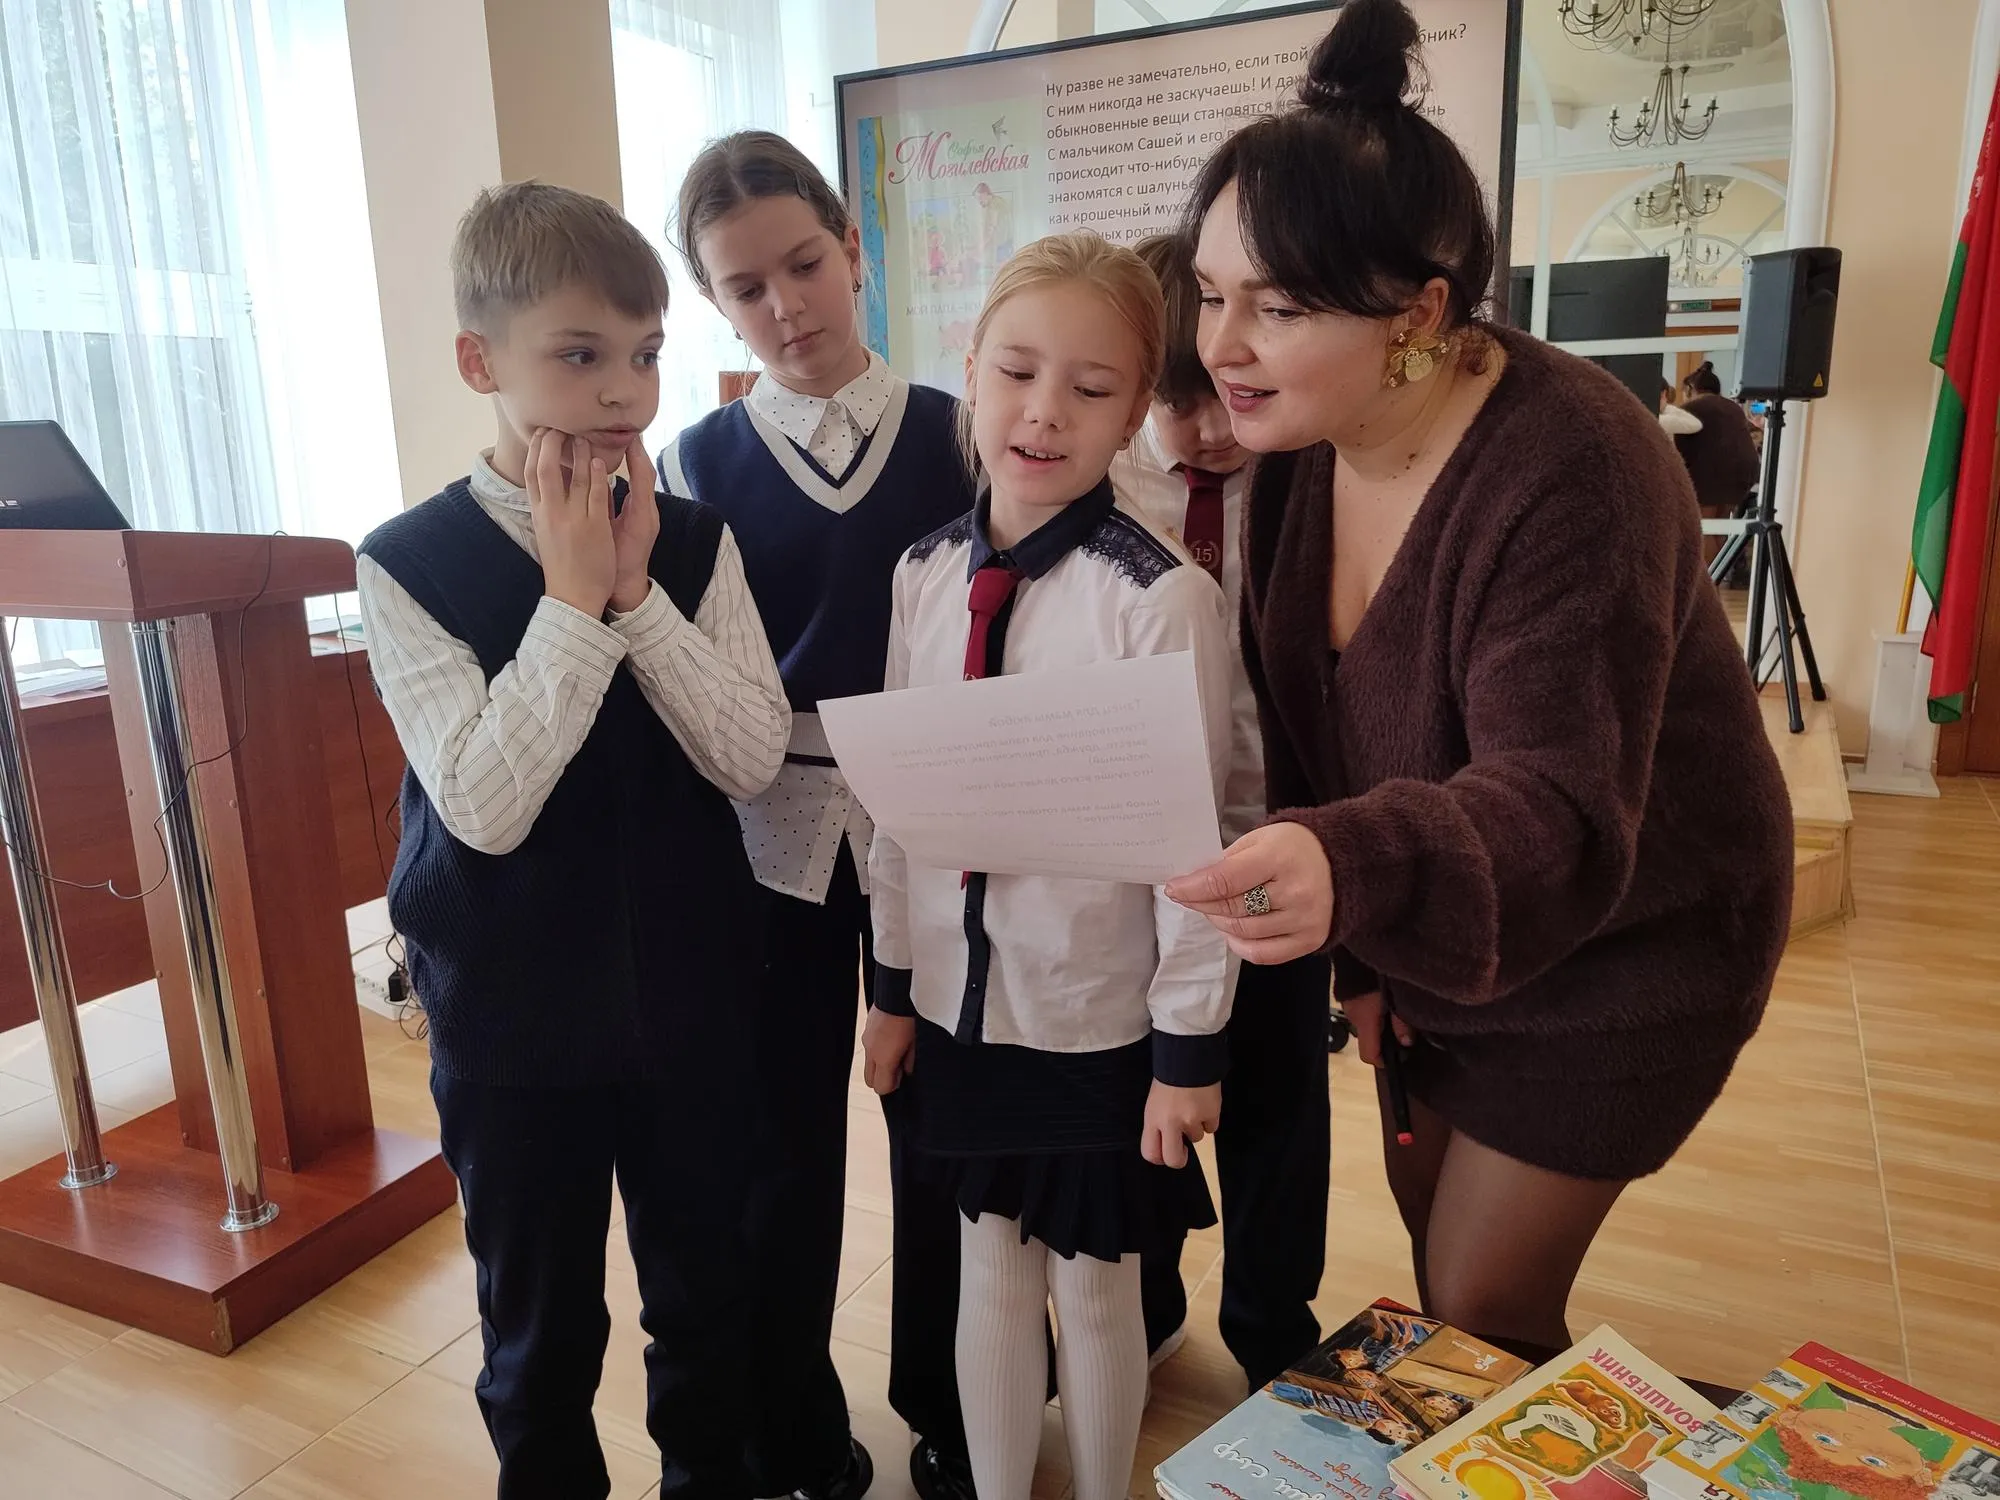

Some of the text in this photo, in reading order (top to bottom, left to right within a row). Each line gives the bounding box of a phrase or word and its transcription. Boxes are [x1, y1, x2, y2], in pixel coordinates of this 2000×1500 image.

[1046, 23, 1467, 98] Ну разве не замечательно, если твой бник?
[1046, 105, 1055, 118] С
[1058, 103, 1085, 117] ним
[1089, 95, 1142, 113] никогда
[1147, 93, 1164, 105] не
[1167, 77, 1256, 101] заскучаешь!
[1261, 76, 1271, 89] И
[1047, 117, 1149, 139] обыкновенные
[1153, 112, 1190, 126] вещи
[1194, 101, 1272, 120] становятся
[888, 131, 1030, 184] Могилевская
[1048, 148, 1056, 160] С
[1059, 142, 1134, 160] мальчиком
[1138, 132, 1183, 150] Сашей
[1187, 135, 1195, 144] и
[1200, 131, 1222, 142] его
[1048, 155, 1205, 184] происходит что-нибудь
[1048, 180, 1196, 203] знакомятся с шалунье
[1049, 202, 1188, 224] как крошечный мухо
[1126, 225, 1171, 241] ростко
[1194, 547, 1212, 562] 15
[1587, 1347, 1704, 1434] ВОЛШЕБНИК
[1212, 1437, 1269, 1478] сыр
